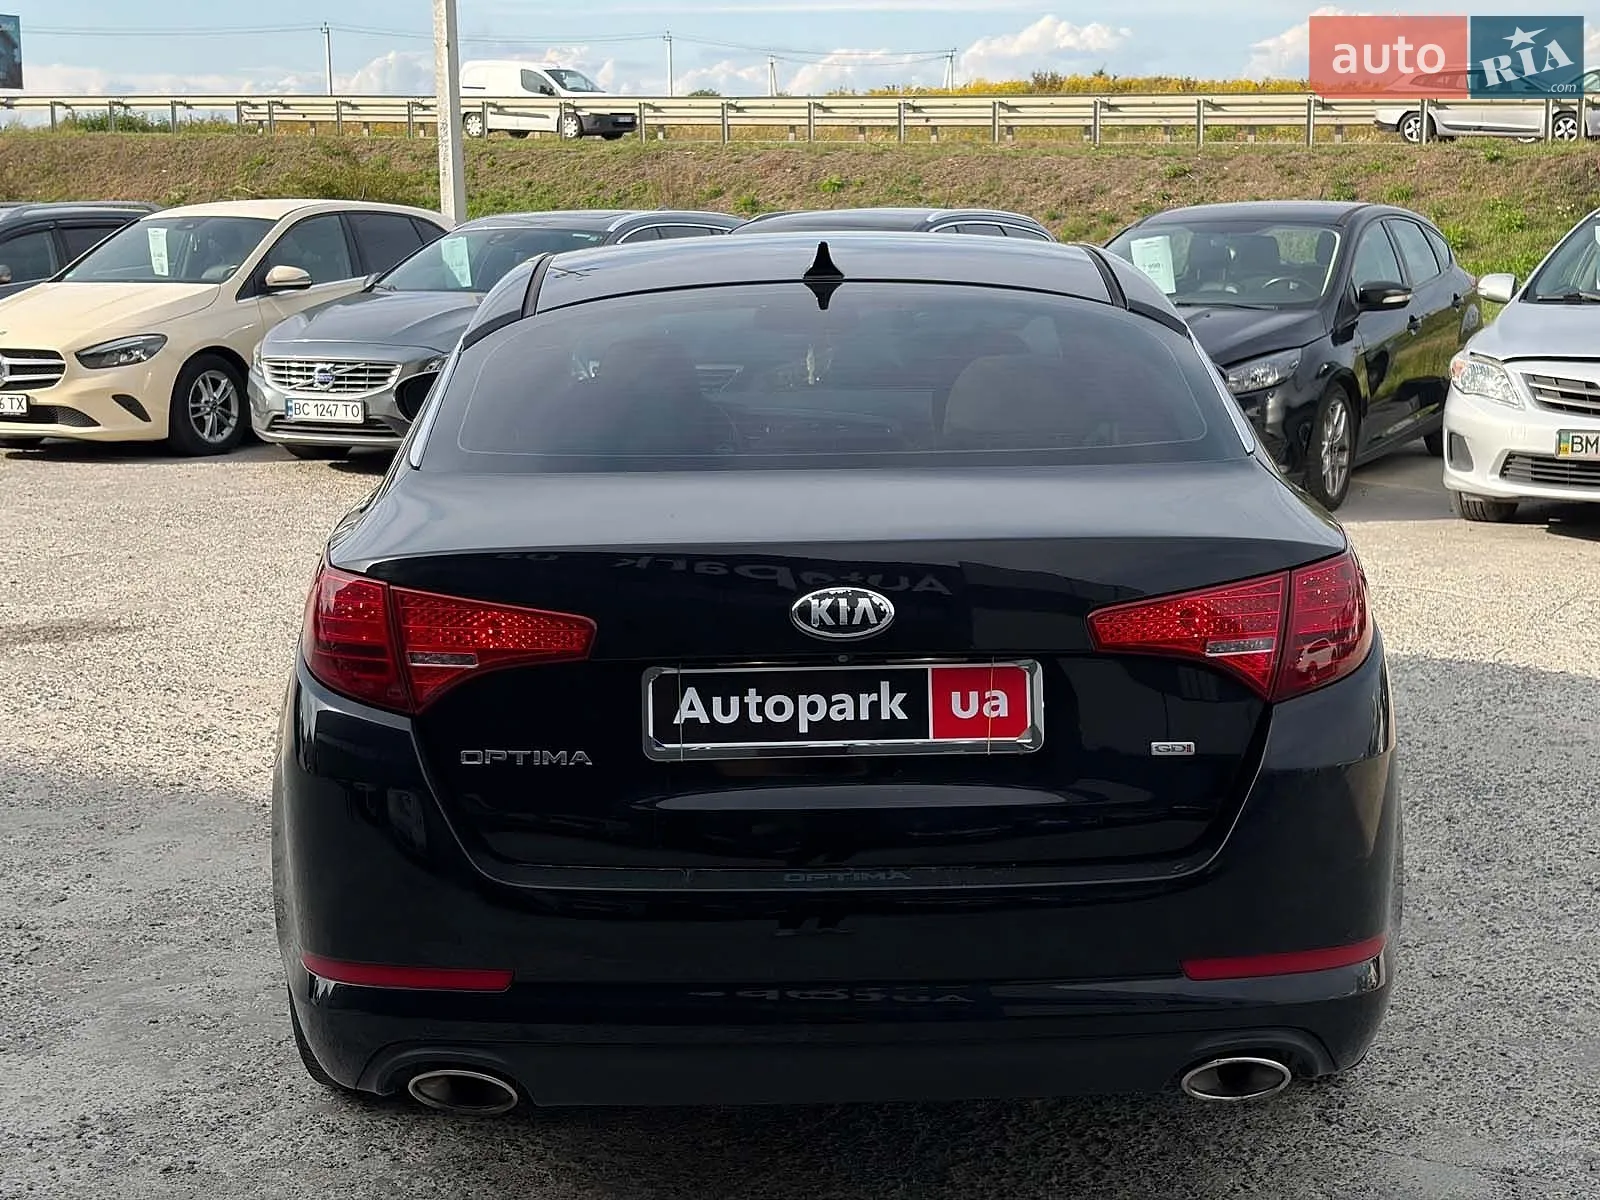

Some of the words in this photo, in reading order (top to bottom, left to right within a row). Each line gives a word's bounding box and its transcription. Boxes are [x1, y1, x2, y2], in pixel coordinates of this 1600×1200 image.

[7, 397, 25, 410] TX
[294, 402, 310, 416] BC
[313, 403, 339, 417] 1247
[342, 403, 360, 418] TO
[1570, 435, 1600, 455] BM
[808, 597, 878, 627] KIA
[672, 681, 909, 734] Autopark
[950, 687, 1010, 720] ua
[460, 749, 593, 766] OPTIMA
[783, 868, 912, 883] OPTIMA
